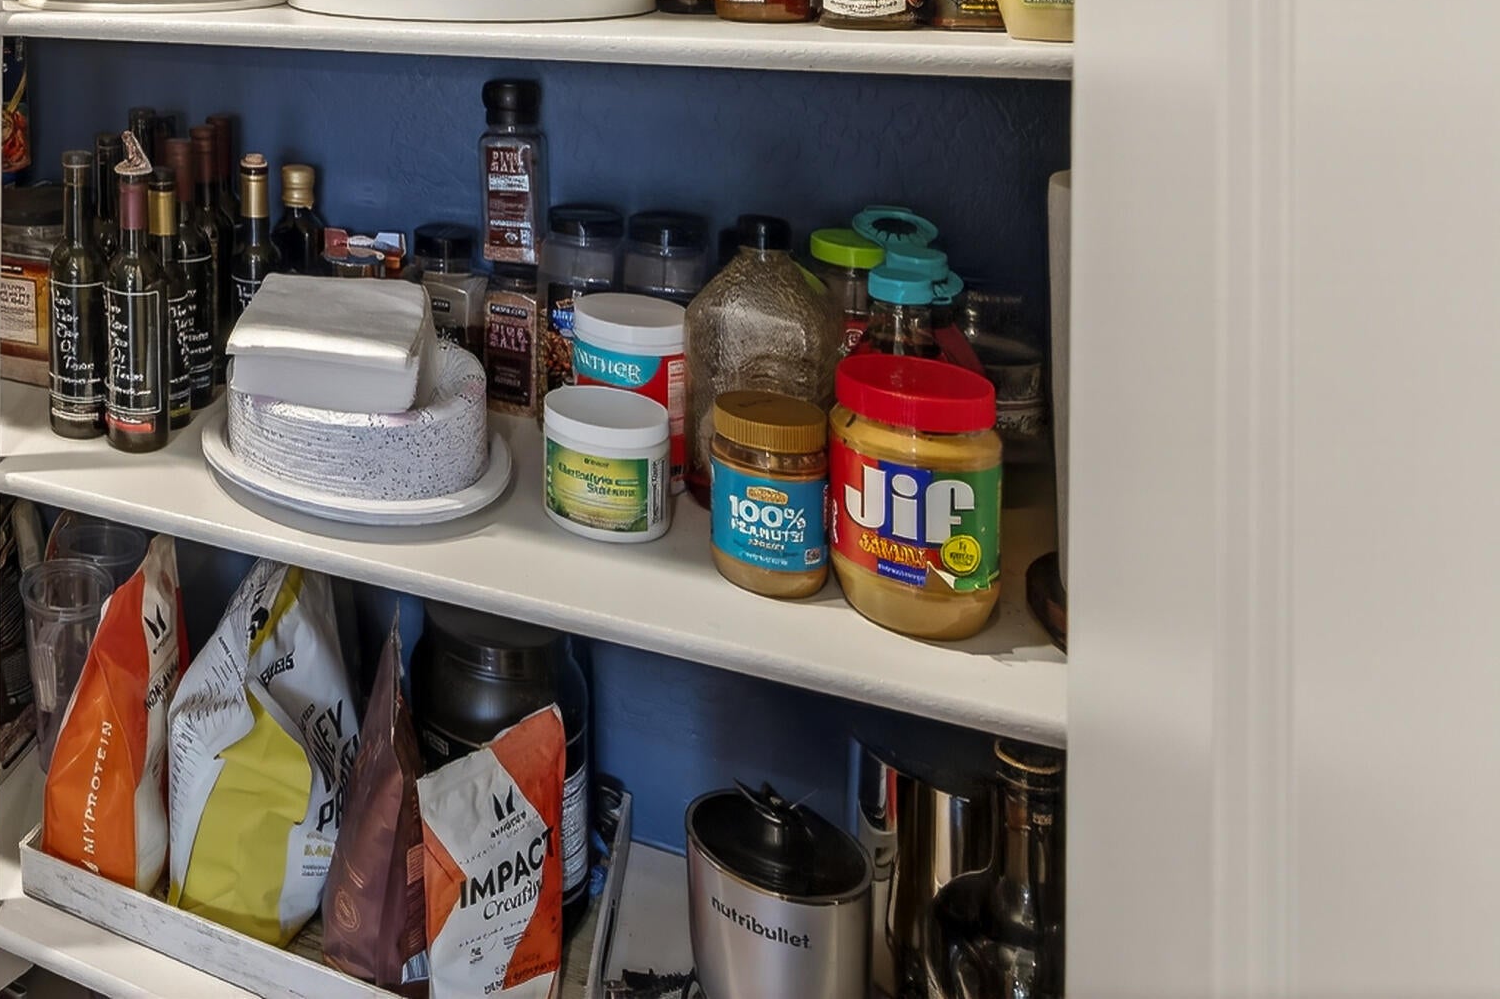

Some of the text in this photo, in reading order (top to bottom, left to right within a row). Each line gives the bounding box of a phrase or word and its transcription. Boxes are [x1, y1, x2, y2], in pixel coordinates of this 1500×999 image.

[728, 494, 807, 530] 100%
[844, 463, 976, 545] Jif
[82, 720, 113, 856] MYPROTEIN
[458, 824, 555, 910] IMPACT
[711, 896, 809, 950] nutribullet
